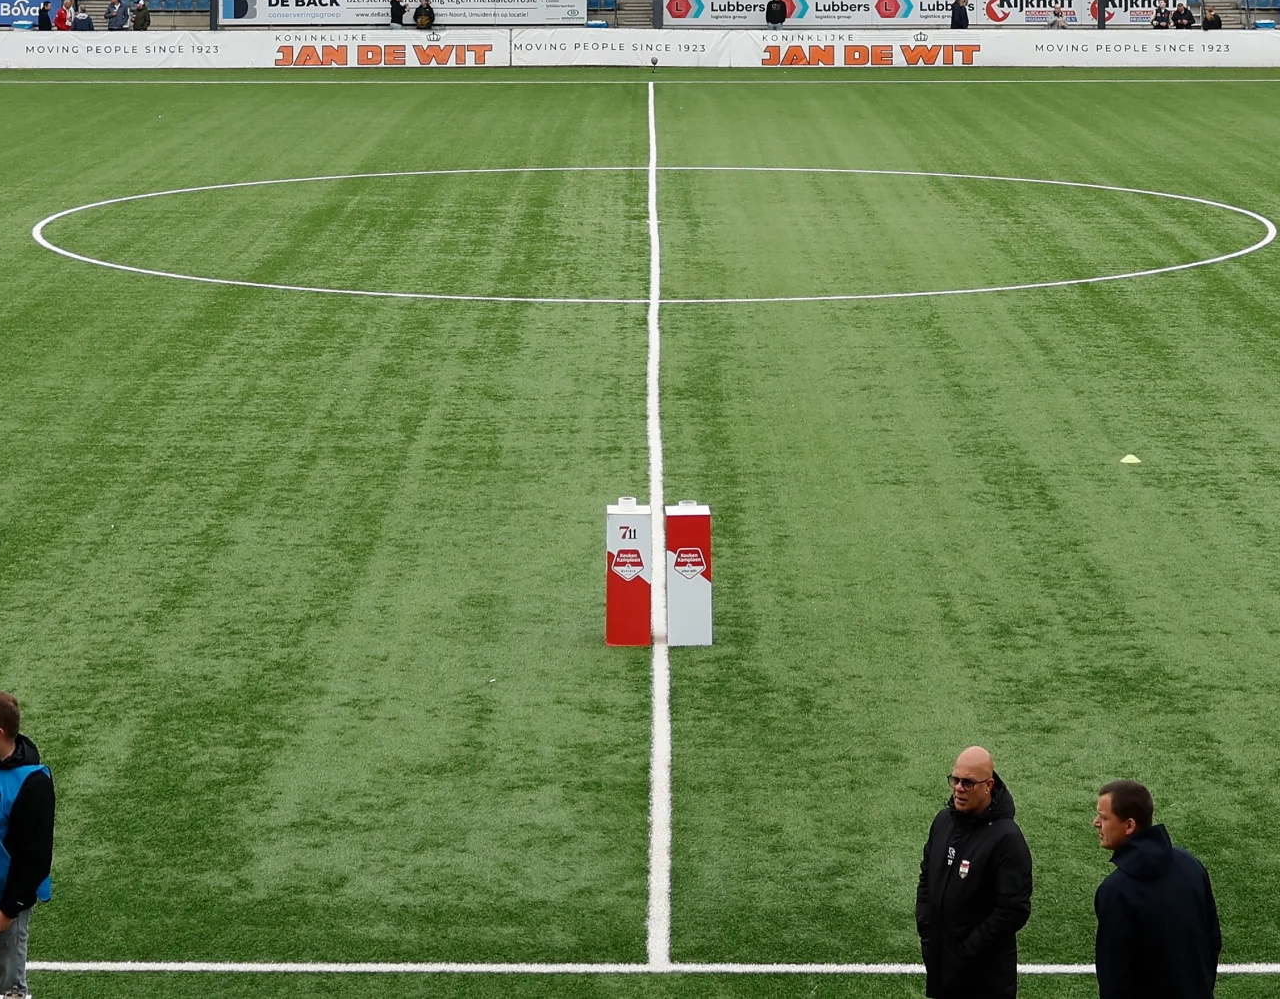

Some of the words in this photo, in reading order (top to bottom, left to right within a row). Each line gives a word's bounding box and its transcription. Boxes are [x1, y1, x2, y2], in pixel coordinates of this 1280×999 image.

[711, 1, 766, 12] Lubbers
[815, 1, 870, 12] Lubbers
[268, 11, 341, 19] conserveringsgroep
[1035, 44, 1090, 53] MOVING
[1096, 44, 1149, 53] PEOPLE
[1155, 44, 1195, 53] SINCE
[1201, 44, 1231, 53] 1923
[761, 45, 834, 66] JAN
[844, 45, 893, 66] DE
[900, 45, 981, 66] WIT
[619, 525, 637, 540] 711
